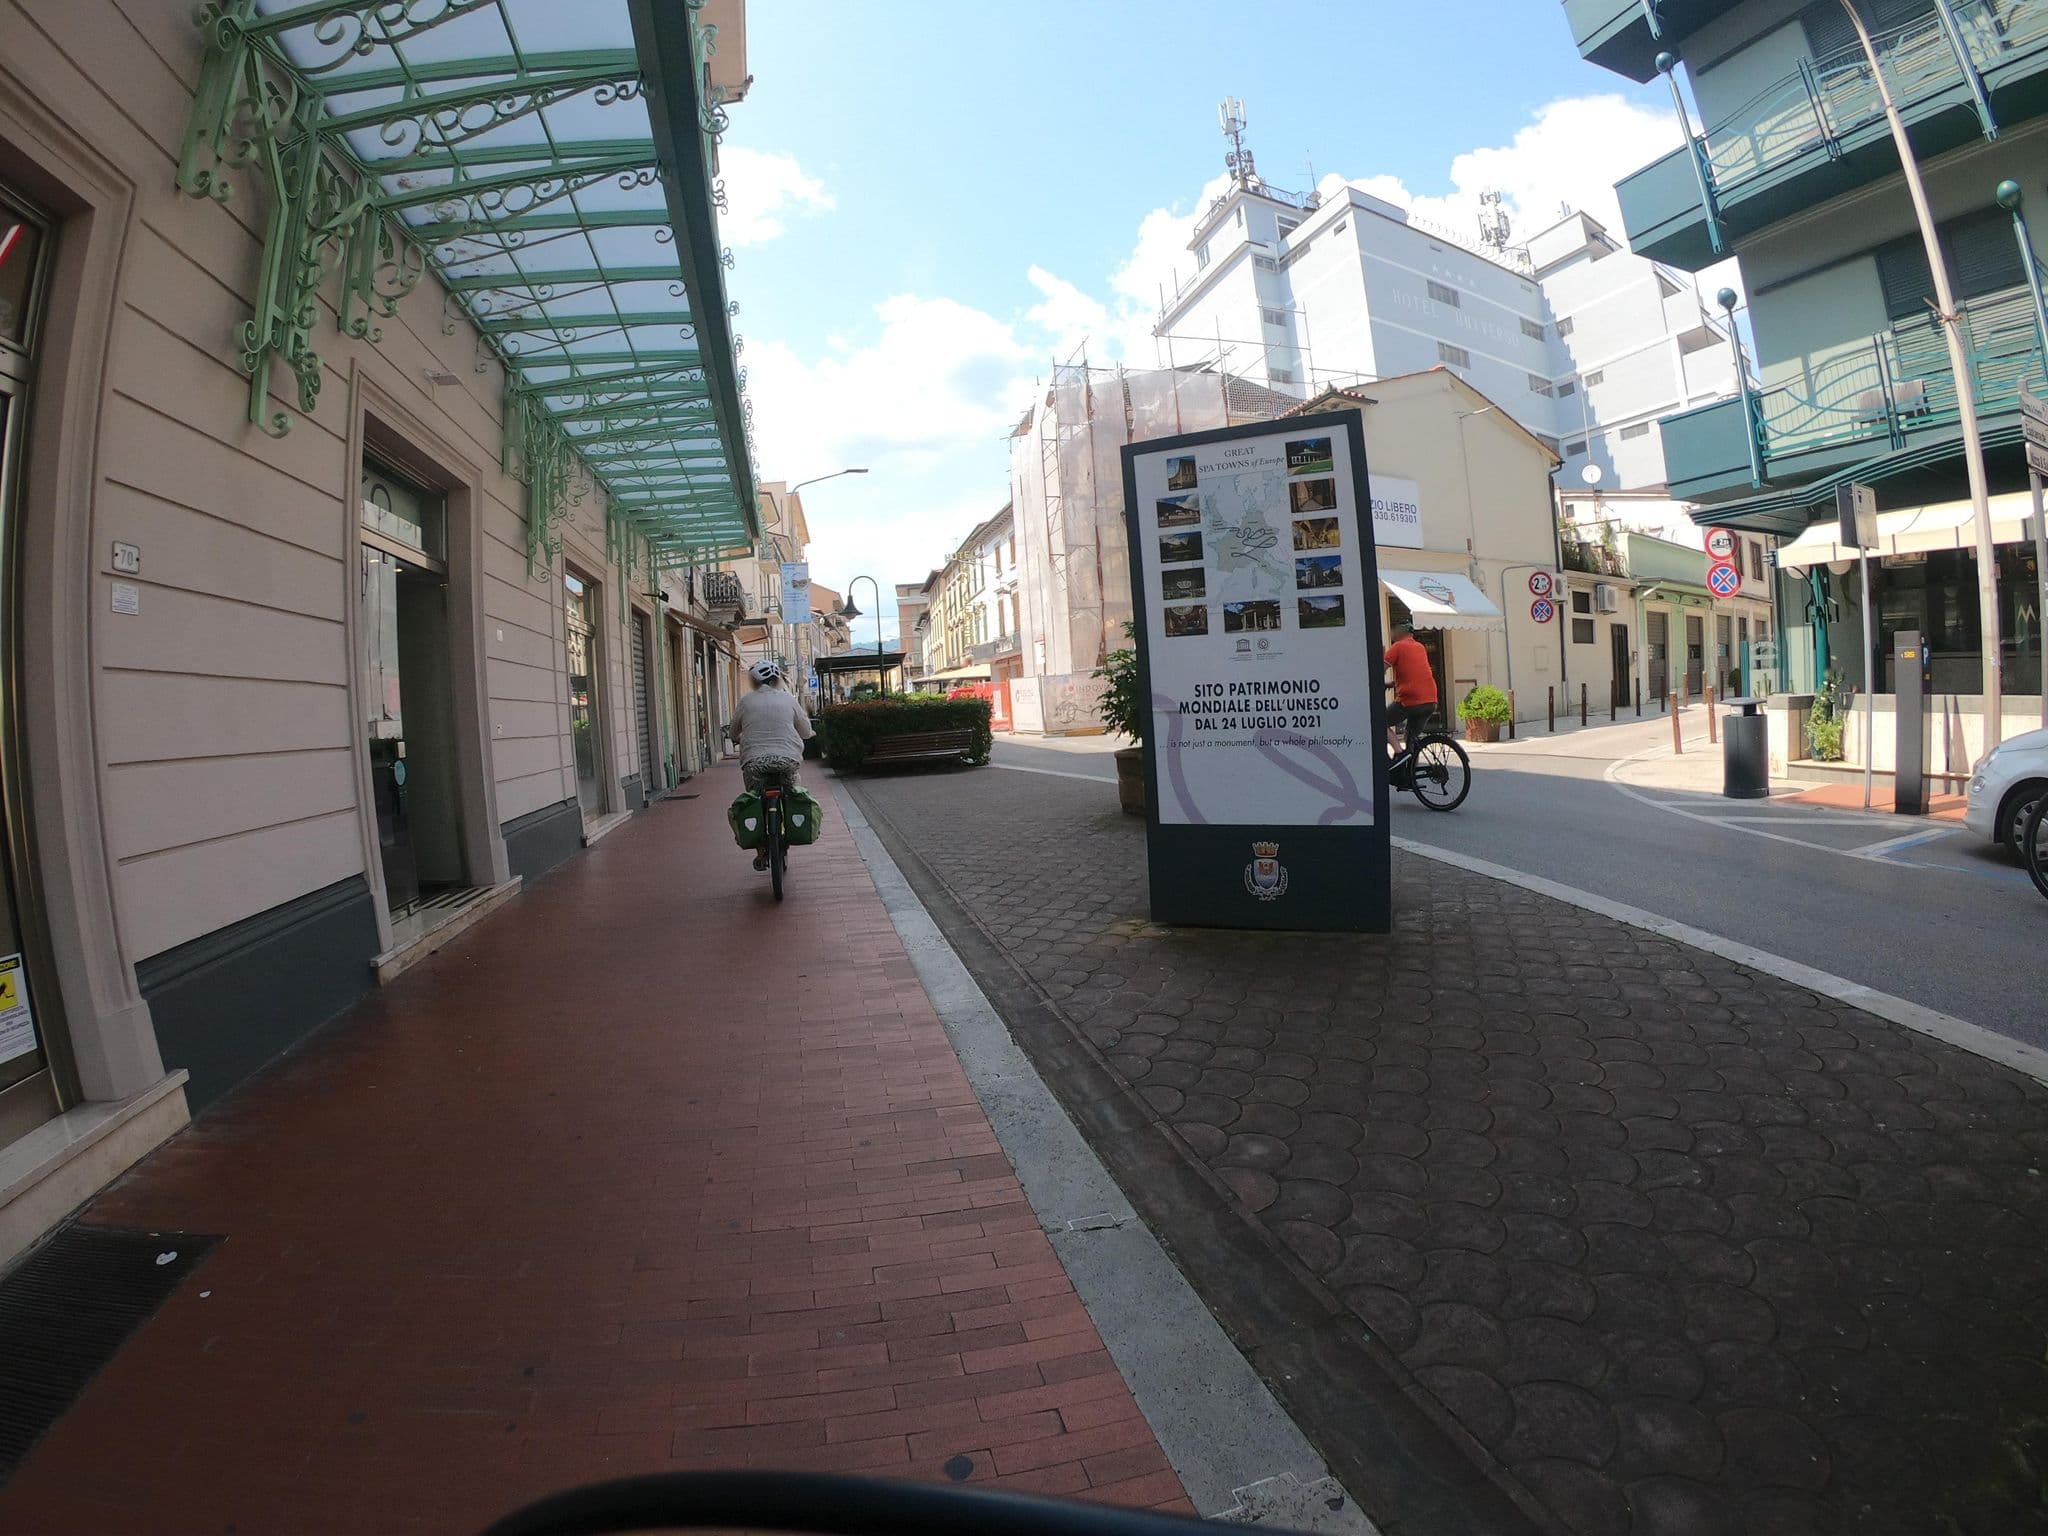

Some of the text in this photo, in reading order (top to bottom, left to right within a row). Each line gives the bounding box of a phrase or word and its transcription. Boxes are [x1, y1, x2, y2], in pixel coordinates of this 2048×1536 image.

[1391, 287, 1440, 320] HOTEL
[1223, 446, 1256, 458] GREAT
[1198, 455, 1285, 473] SPA TOWNS of Europe
[1385, 500, 1417, 515] LIBERO
[120, 549, 134, 566] 70
[1923, 647, 1929, 665] P
[1194, 679, 1320, 697] SITO PATRIMONIO
[1179, 697, 1339, 714] MONDIALE DELL'UNESCO
[1195, 715, 1321, 730] DAL 24 LUGLIO 2021
[1178, 739, 1191, 748] not
[1192, 739, 1206, 749] just
[1214, 738, 1257, 748] monument,
[1259, 735, 1272, 747] but
[1281, 736, 1306, 746] whole
[1308, 735, 1353, 749] philosophy
